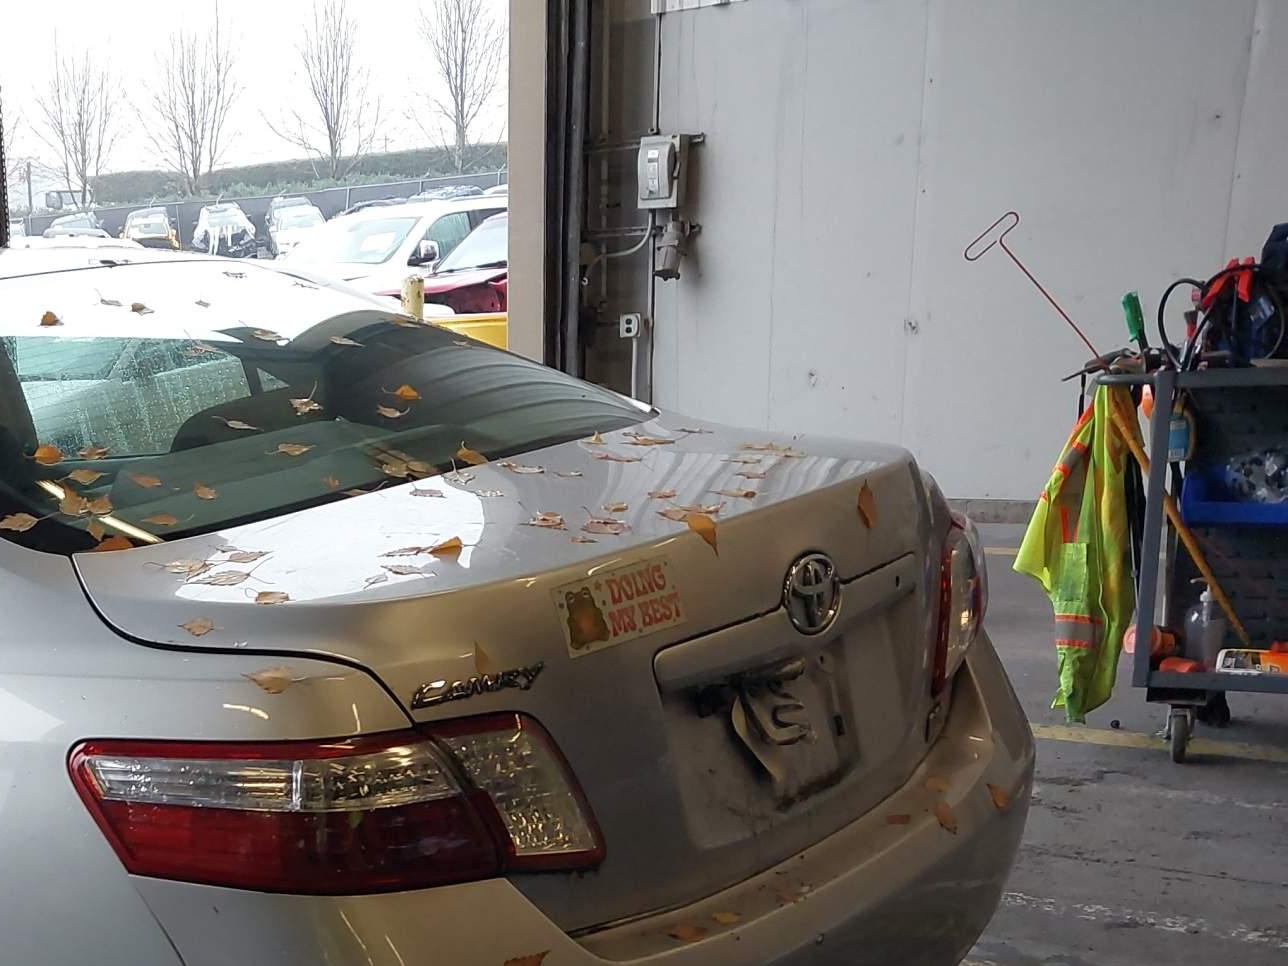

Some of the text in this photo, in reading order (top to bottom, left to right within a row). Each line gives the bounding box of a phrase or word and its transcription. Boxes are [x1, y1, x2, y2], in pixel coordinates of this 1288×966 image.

[605, 564, 667, 606] DOING
[607, 591, 682, 638] MY BEST
